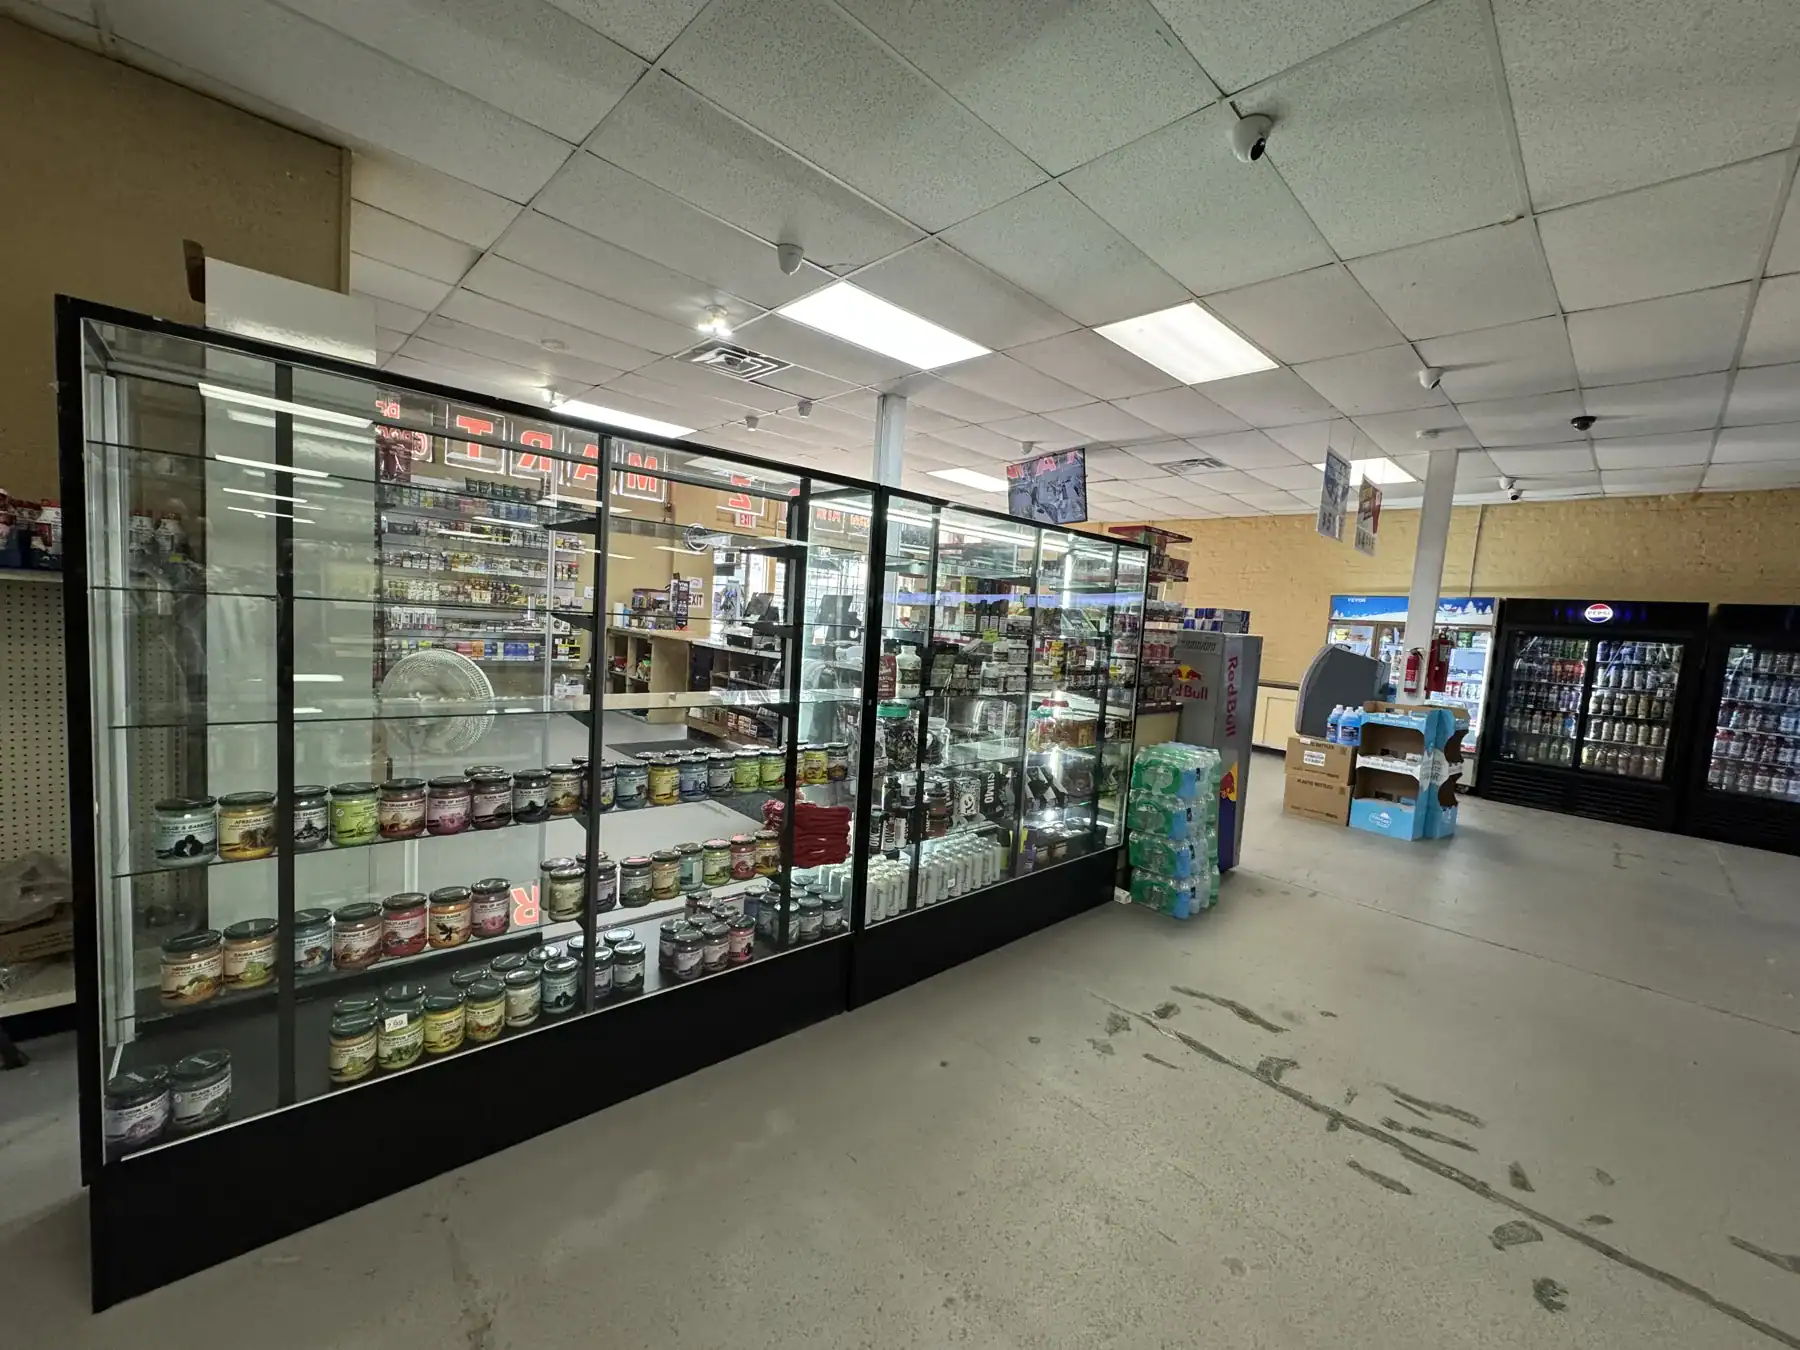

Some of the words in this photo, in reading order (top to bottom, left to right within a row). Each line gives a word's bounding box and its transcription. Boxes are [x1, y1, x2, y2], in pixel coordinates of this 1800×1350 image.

[740, 514, 753, 527] EXIT
[688, 593, 704, 607] EXIT
[1227, 655, 1239, 699] Red
[1184, 685, 1208, 701] Bull
[1226, 699, 1238, 737] Bull
